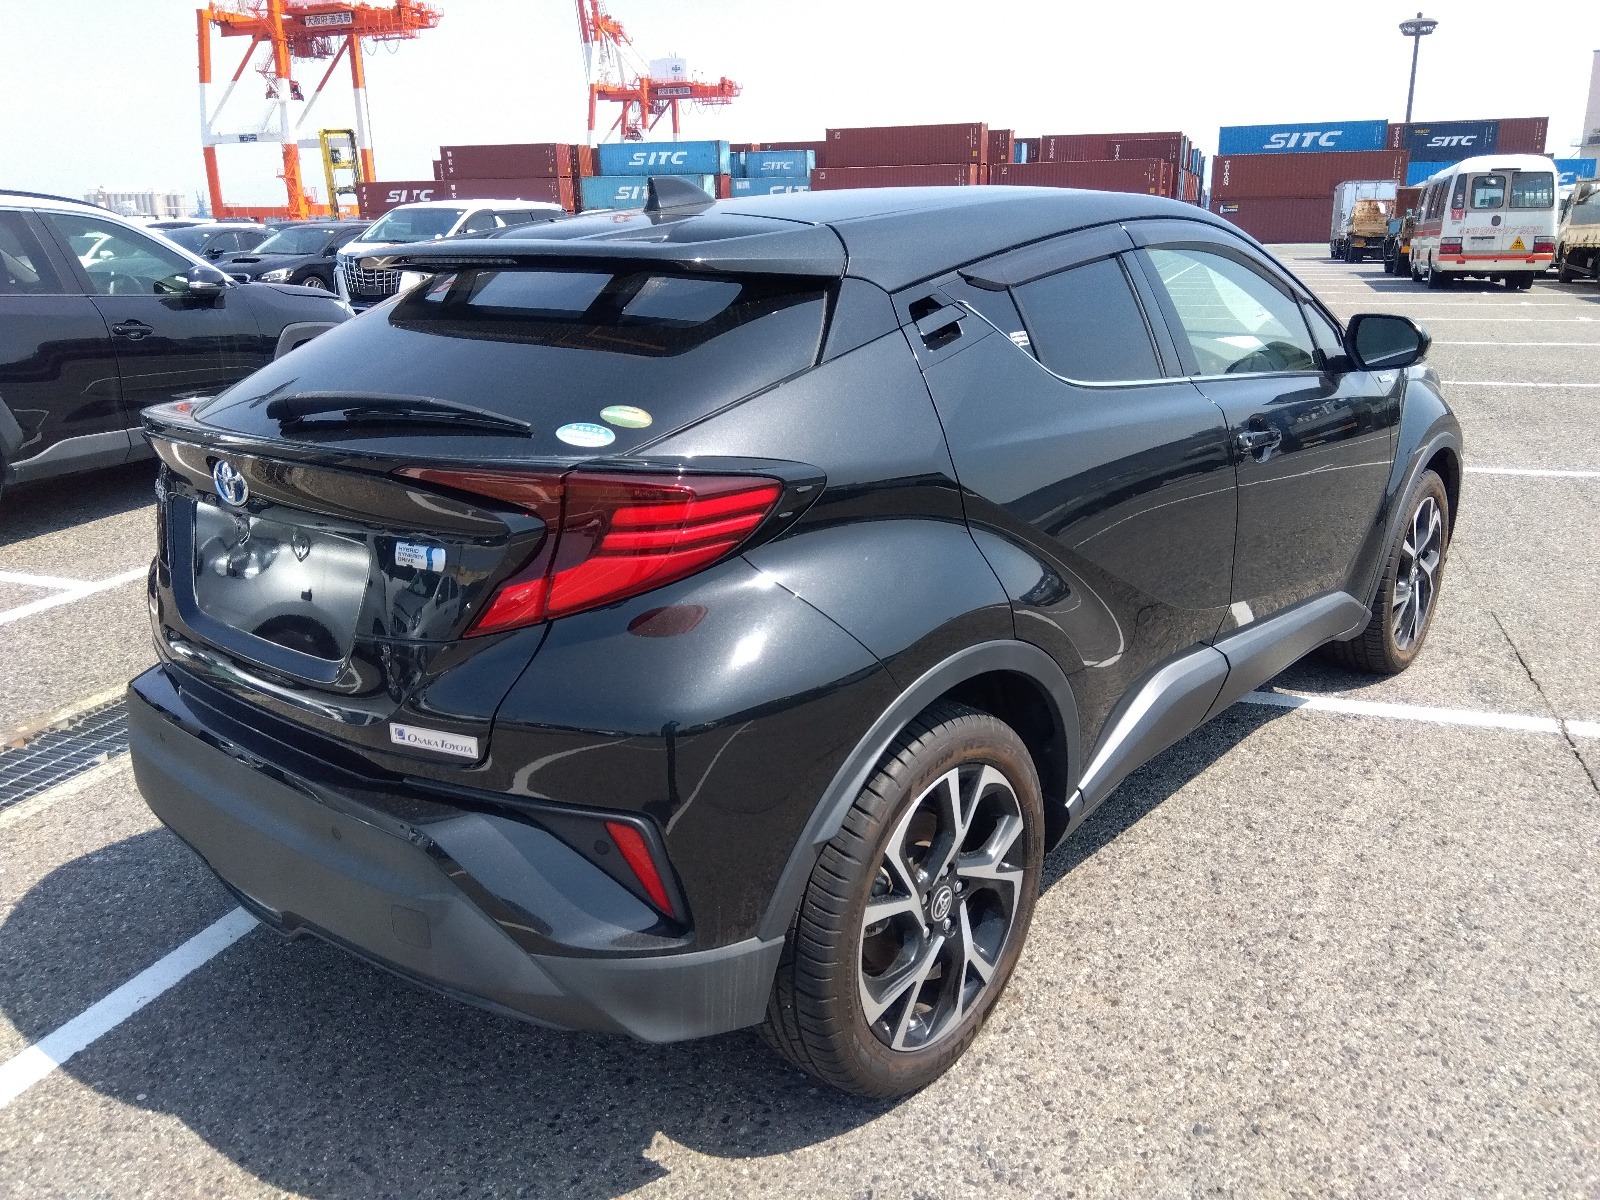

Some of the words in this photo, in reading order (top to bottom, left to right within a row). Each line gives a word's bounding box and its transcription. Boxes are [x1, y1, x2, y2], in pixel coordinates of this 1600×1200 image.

[1262, 130, 1344, 150] SITC
[1426, 134, 1478, 148] SITC
[628, 151, 688, 166] SITC
[760, 161, 794, 171] SITC
[398, 546, 420, 554] HYBRID
[398, 551, 424, 560] SYNERGY
[397, 556, 415, 564] DRIVE
[407, 733, 439, 748] OSAKA
[441, 739, 473, 754] TOYOTA
